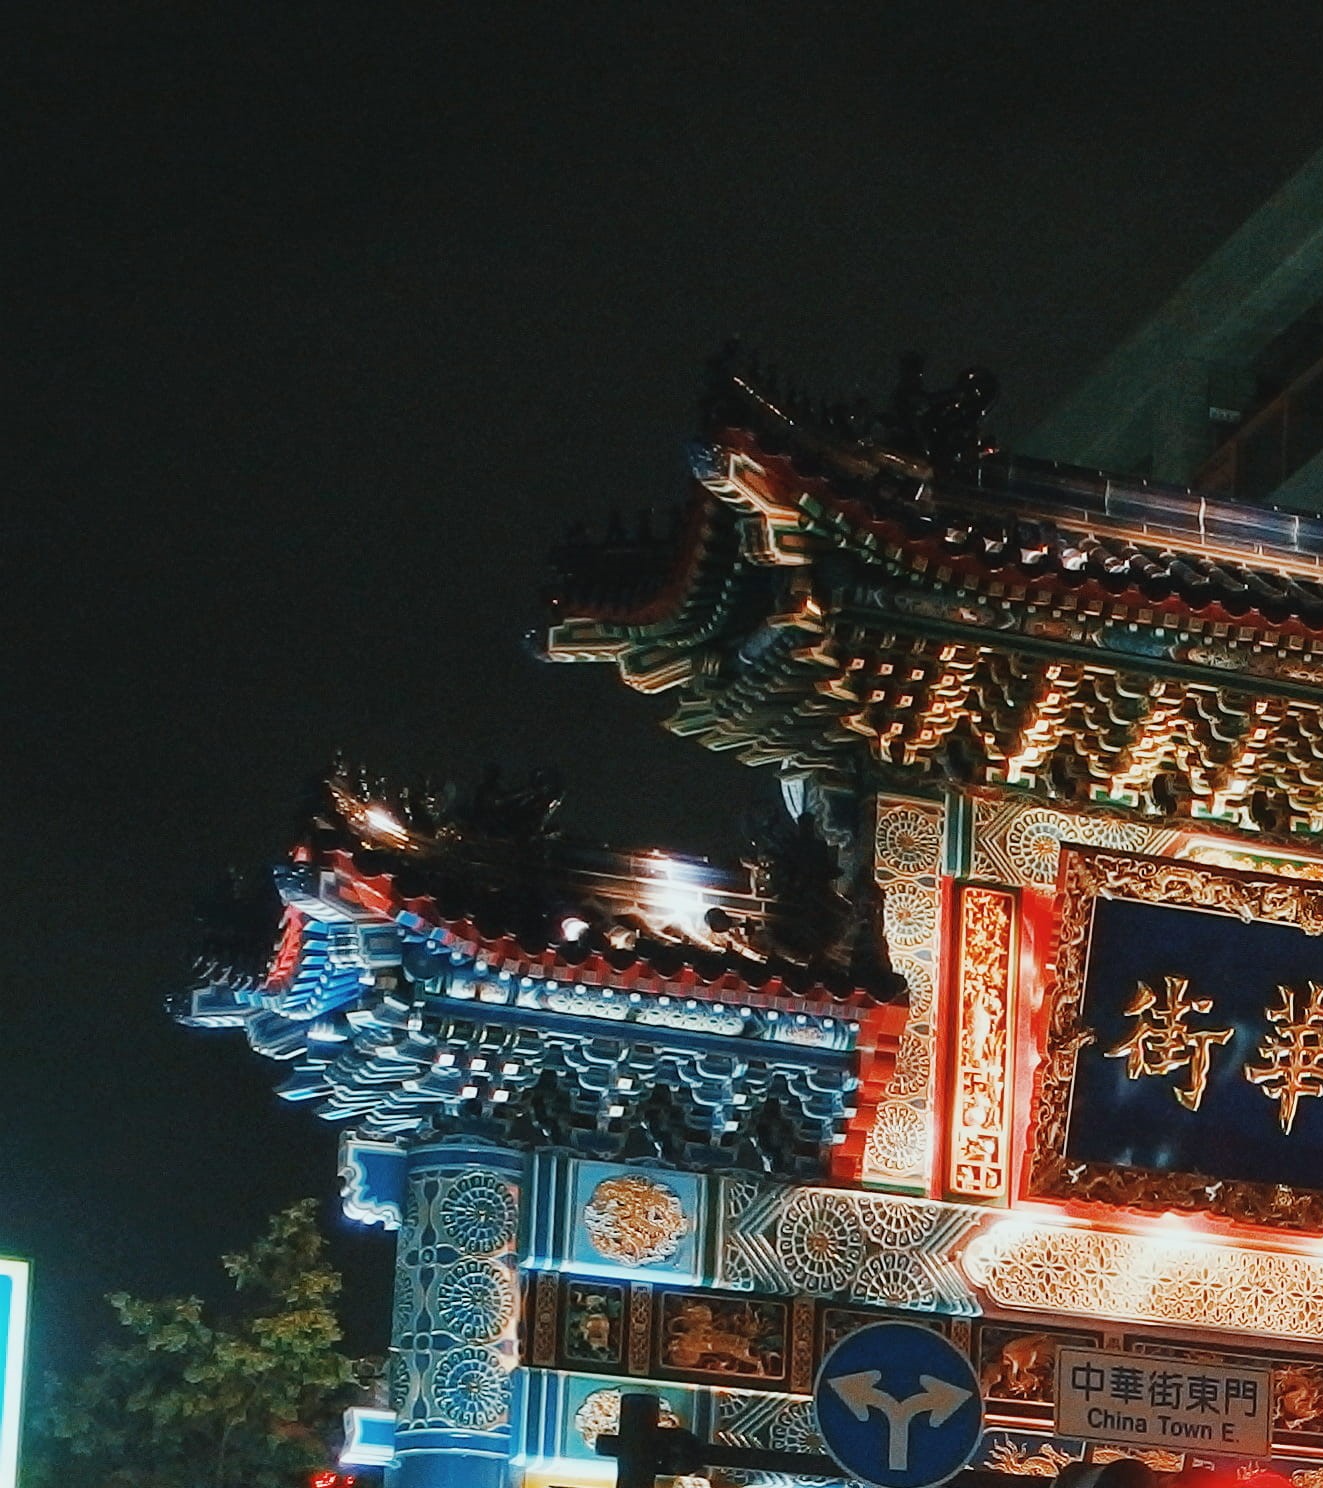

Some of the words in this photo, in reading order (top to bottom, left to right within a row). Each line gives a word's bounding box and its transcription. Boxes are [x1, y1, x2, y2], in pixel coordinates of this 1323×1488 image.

[1071, 1362, 1258, 1418] 中華街東門
[1087, 1407, 1147, 1433] China
[1158, 1415, 1212, 1440] Town
[1221, 1423, 1240, 1443] E.
